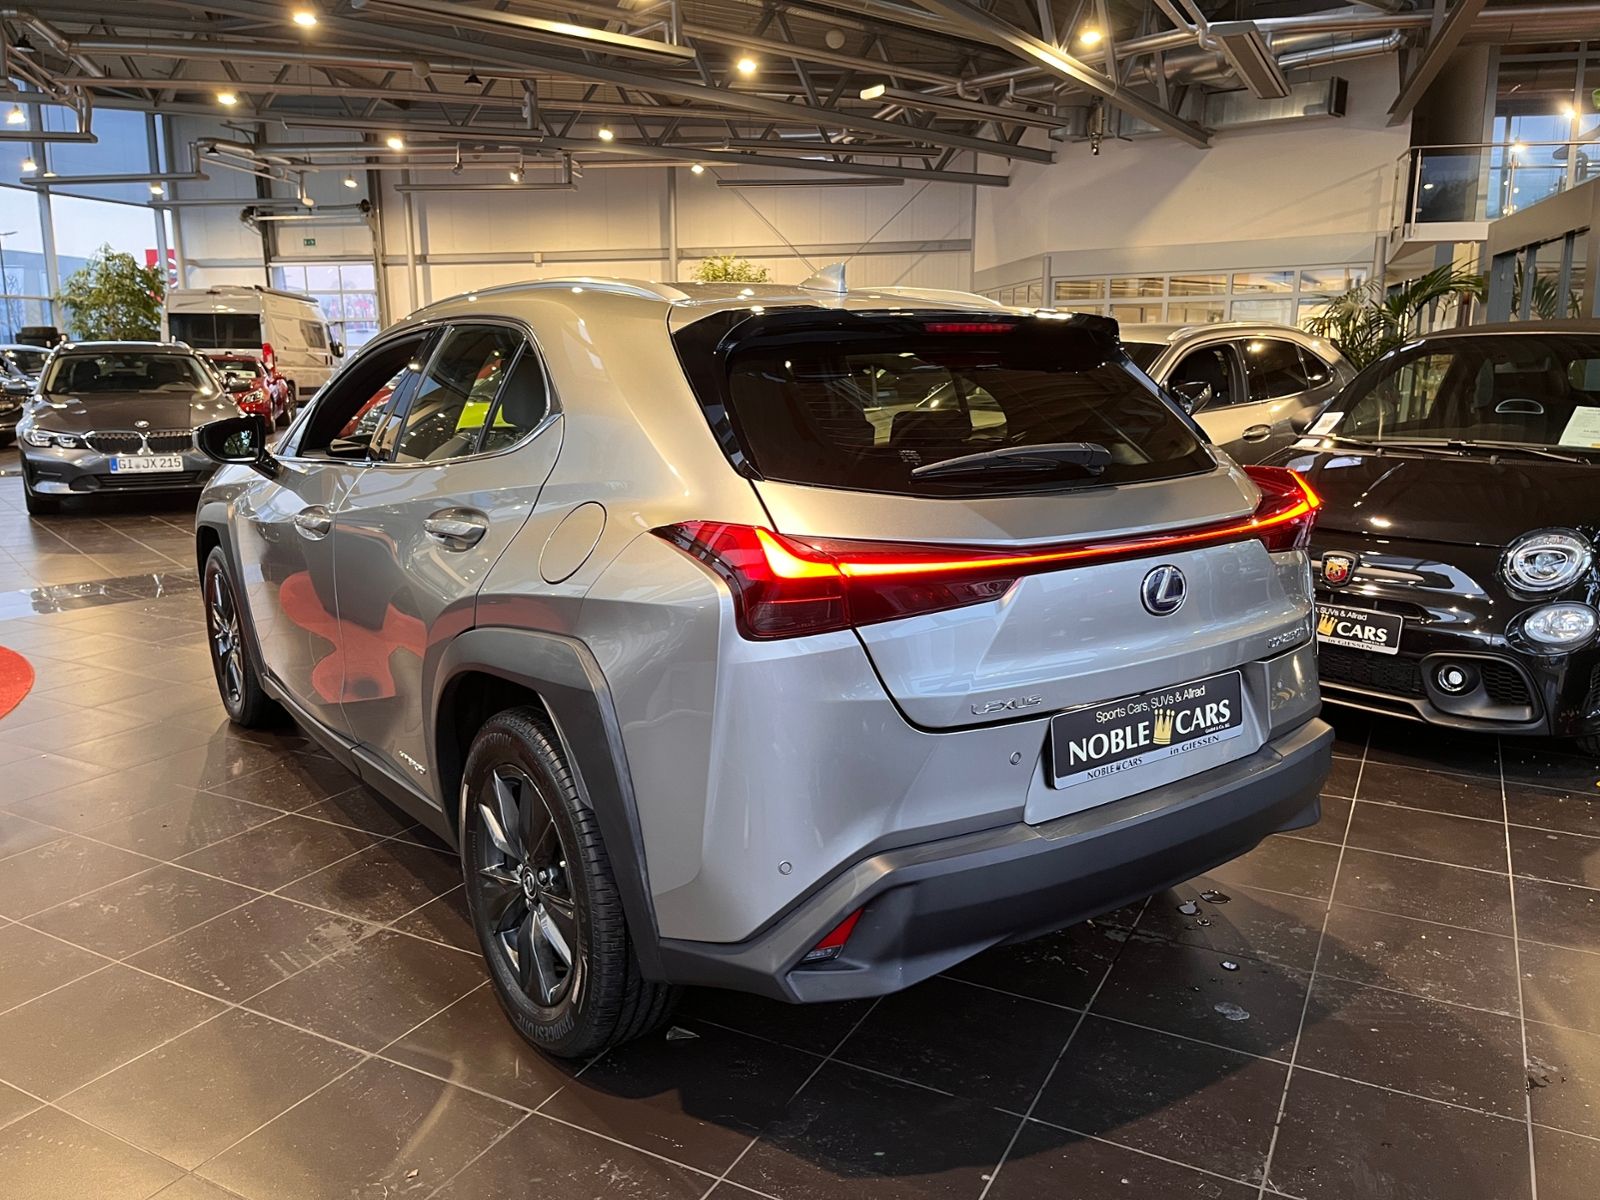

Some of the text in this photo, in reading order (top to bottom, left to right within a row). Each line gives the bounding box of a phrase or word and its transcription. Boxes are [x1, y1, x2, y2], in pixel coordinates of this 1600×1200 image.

[160, 457, 181, 468] 215
[1320, 606, 1338, 616] SUVs
[1340, 609, 1346, 617] &
[1347, 611, 1368, 621] Allrad
[1336, 621, 1388, 643] CARS
[971, 694, 1042, 715] LEXUS
[1096, 685, 1206, 724] Sports Cars, SUVs & Allrad
[1068, 699, 1231, 766] NOBLE CARS
[1086, 735, 1220, 780] NOBLE CARS in GIESSEN
